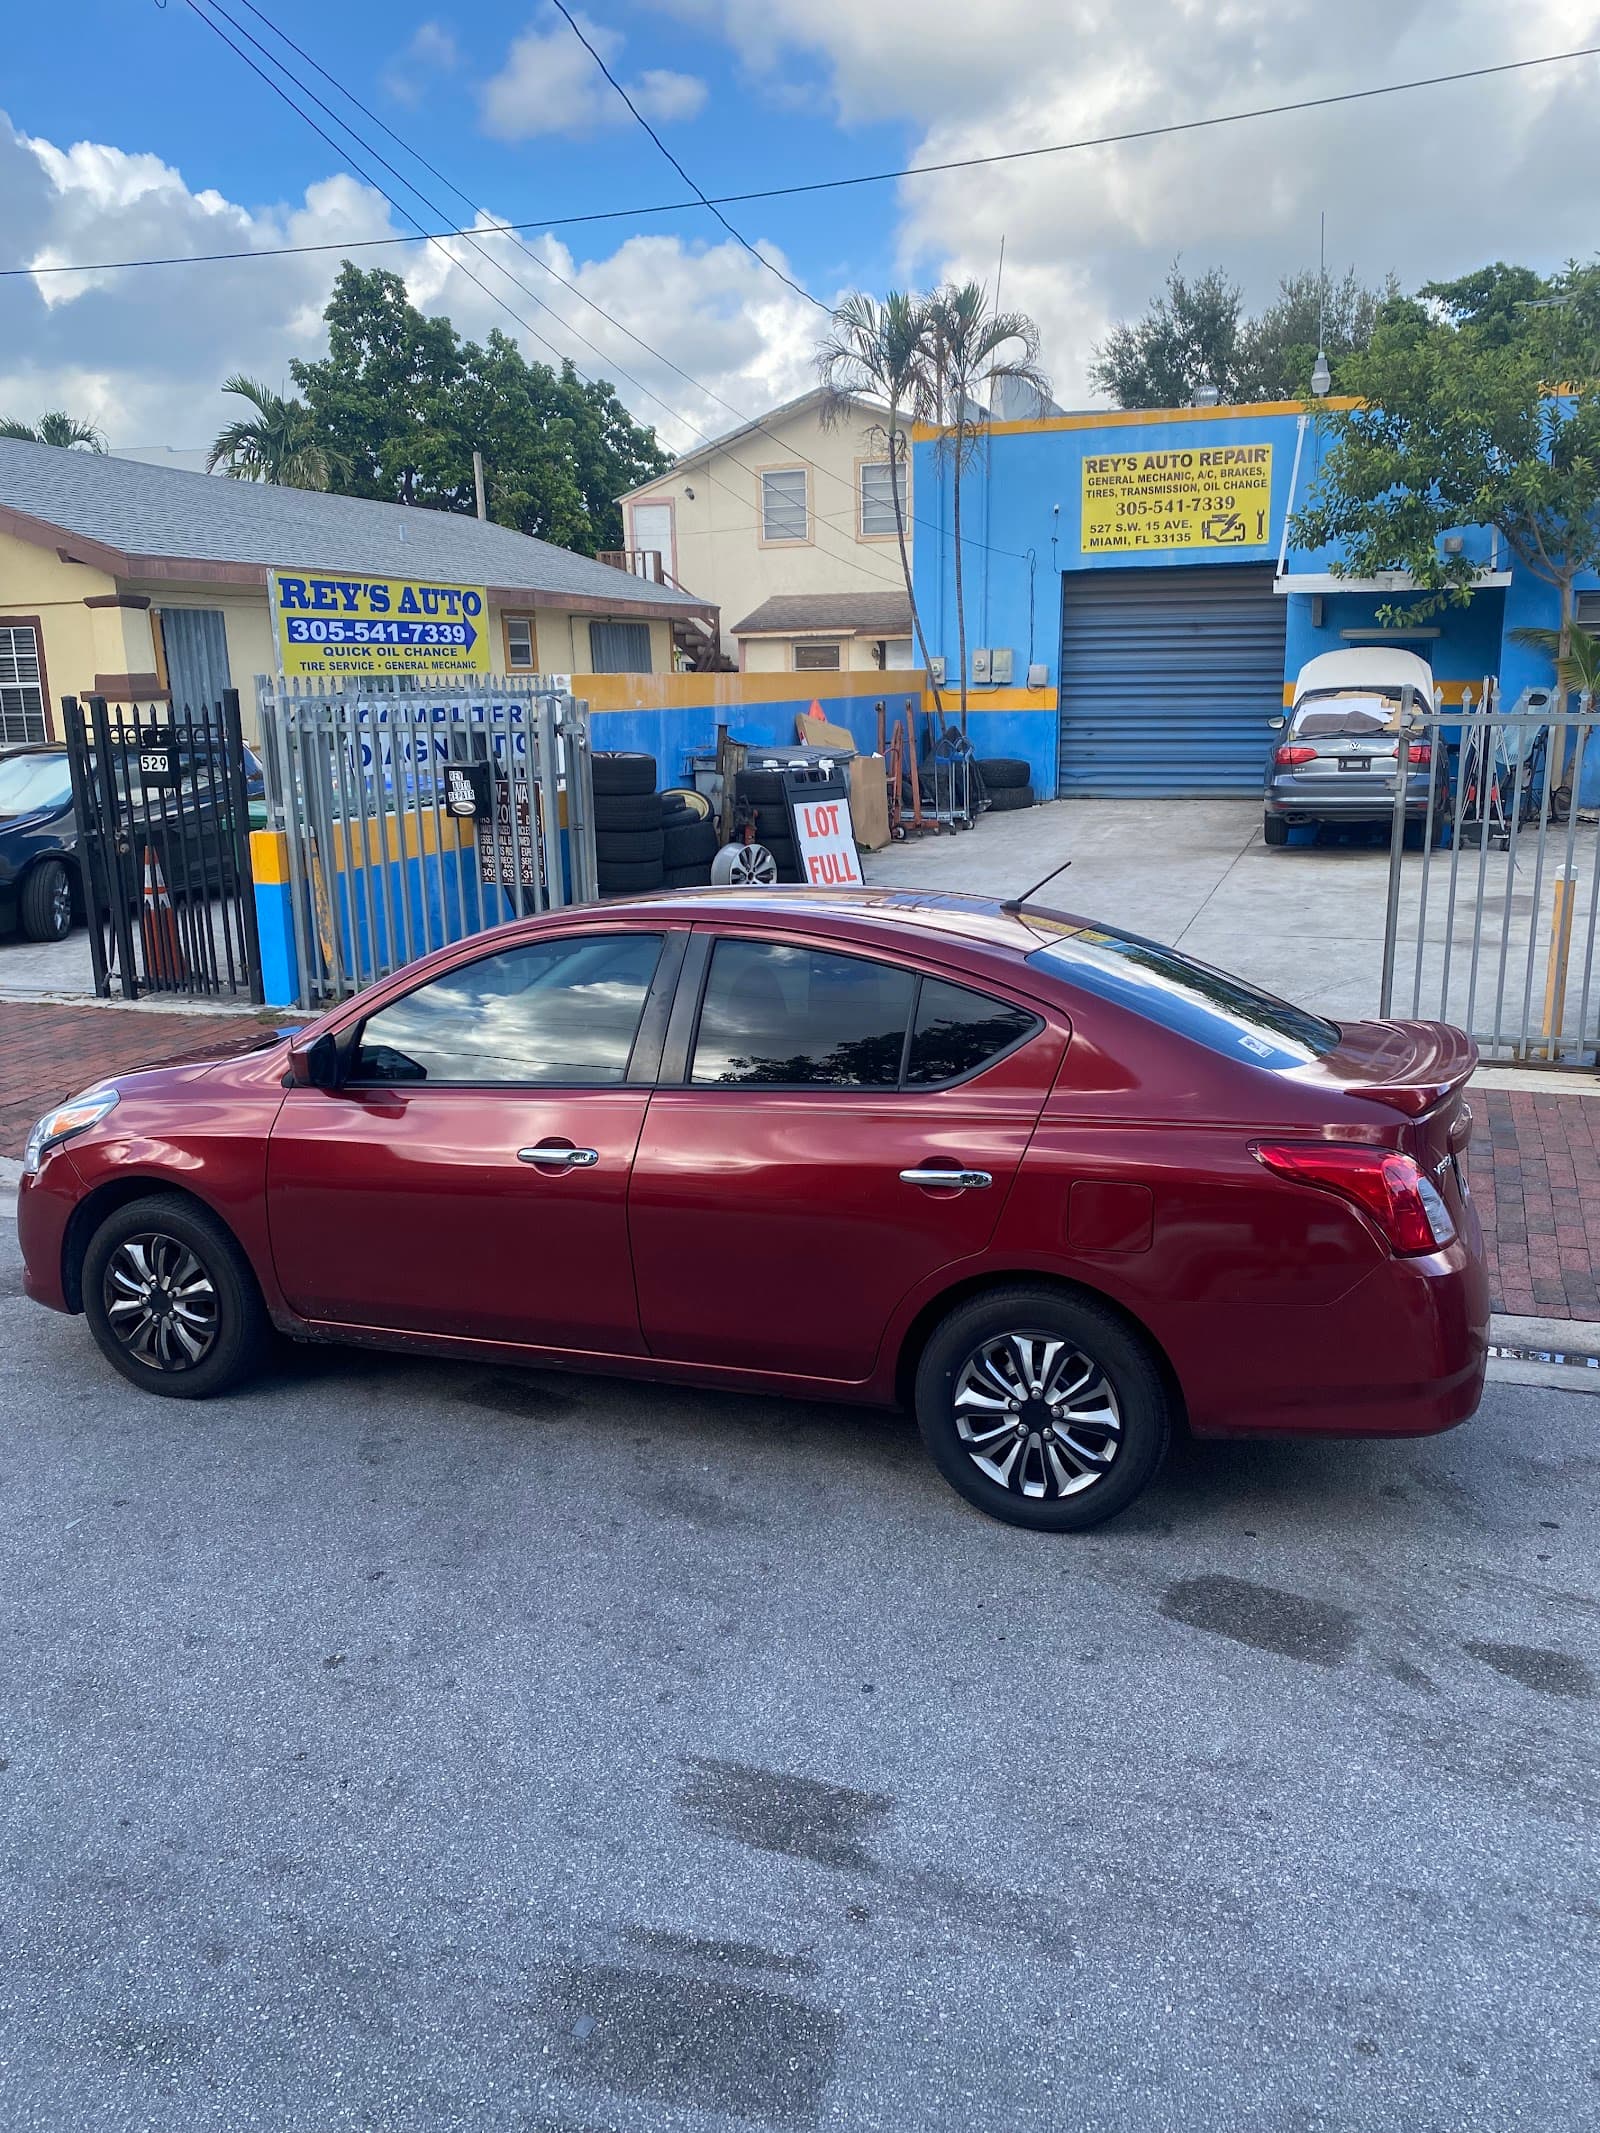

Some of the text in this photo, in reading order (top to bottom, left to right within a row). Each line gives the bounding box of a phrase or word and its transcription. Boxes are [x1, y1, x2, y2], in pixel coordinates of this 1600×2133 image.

[1086, 448, 1266, 474] REY'S AUTO REPAIR
[1088, 467, 1266, 487] GENERAL MECHANIC, A/C, BRAKES,
[1086, 479, 1267, 498] TIRES, TRANSMISSION, OIL CHANGE
[1115, 495, 1236, 516] 305-541-7339
[1090, 519, 1193, 534] 527 S.W. 15 AVE.
[1090, 532, 1191, 547] MIAMI, FL 33135
[278, 577, 482, 617] REY'S AUTO
[291, 619, 466, 643] 305-541-7339
[323, 646, 372, 657] QUICK
[377, 647, 400, 656] OIL
[300, 661, 477, 671] TIRE SERVICE GENERAL MECHANIC
[143, 757, 167, 770] 529
[448, 790, 475, 801] REPAIR
[803, 805, 839, 838] LOT
[808, 852, 858, 885] FULL
